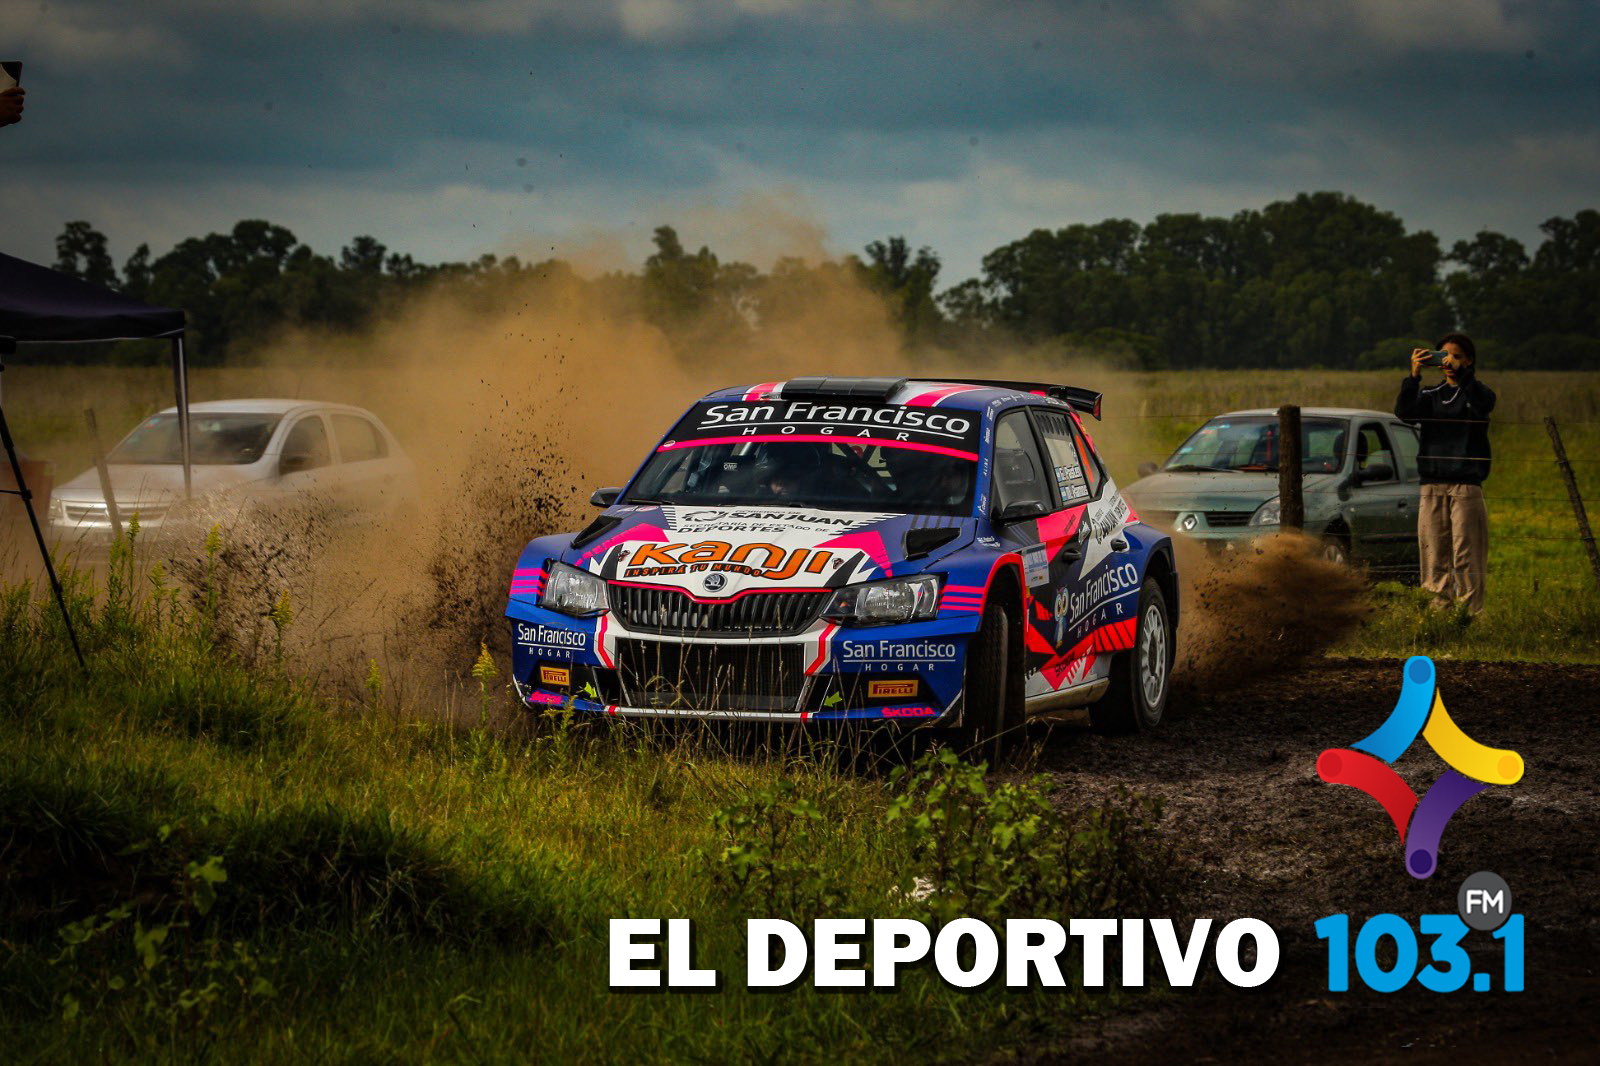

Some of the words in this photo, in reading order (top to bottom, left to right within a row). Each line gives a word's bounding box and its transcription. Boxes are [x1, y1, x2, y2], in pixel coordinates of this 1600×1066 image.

[701, 405, 775, 425] San
[783, 402, 970, 434] Francisco
[742, 426, 910, 442] HOGAR
[677, 525, 787, 533] DEPORTES
[690, 564, 707, 572] TU
[710, 563, 761, 577] MUNDO
[1070, 592, 1085, 624] San
[1085, 563, 1138, 610] Francisco
[1076, 602, 1123, 639] HOGAR
[518, 623, 536, 642] San
[538, 625, 586, 646] Francisco
[528, 647, 570, 658] HOGAR
[842, 640, 875, 658] San
[880, 640, 956, 658] Francisco
[865, 663, 935, 671] HOGAR
[872, 683, 914, 695] PIRELLI
